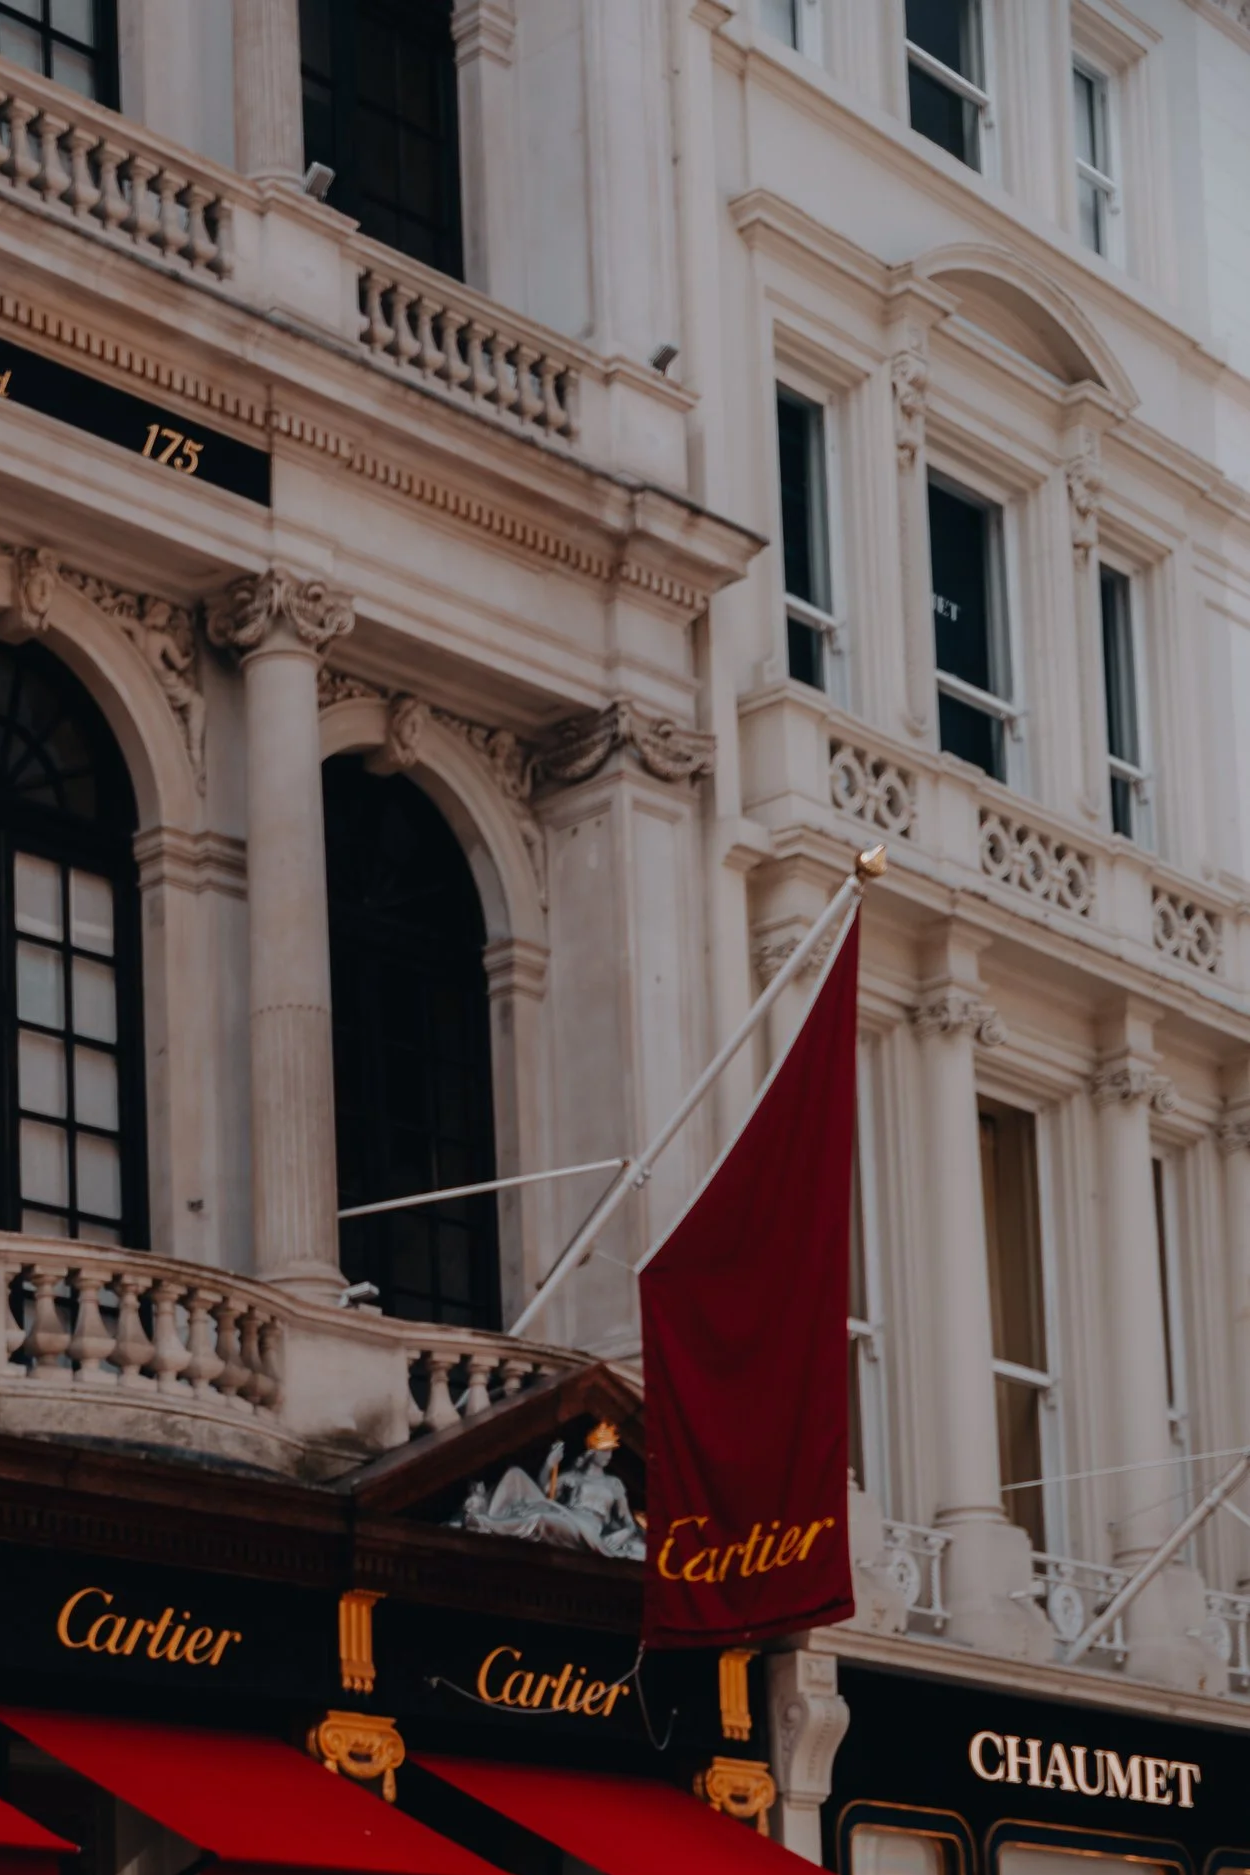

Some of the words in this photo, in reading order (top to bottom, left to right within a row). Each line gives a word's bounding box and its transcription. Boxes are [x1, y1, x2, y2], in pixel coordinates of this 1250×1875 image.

[142, 423, 204, 476] 175
[657, 1516, 836, 1584] Cartier
[55, 1586, 242, 1667] Cartier
[476, 1646, 631, 1717] Cartier
[968, 1730, 1202, 1809] CHAUMET
